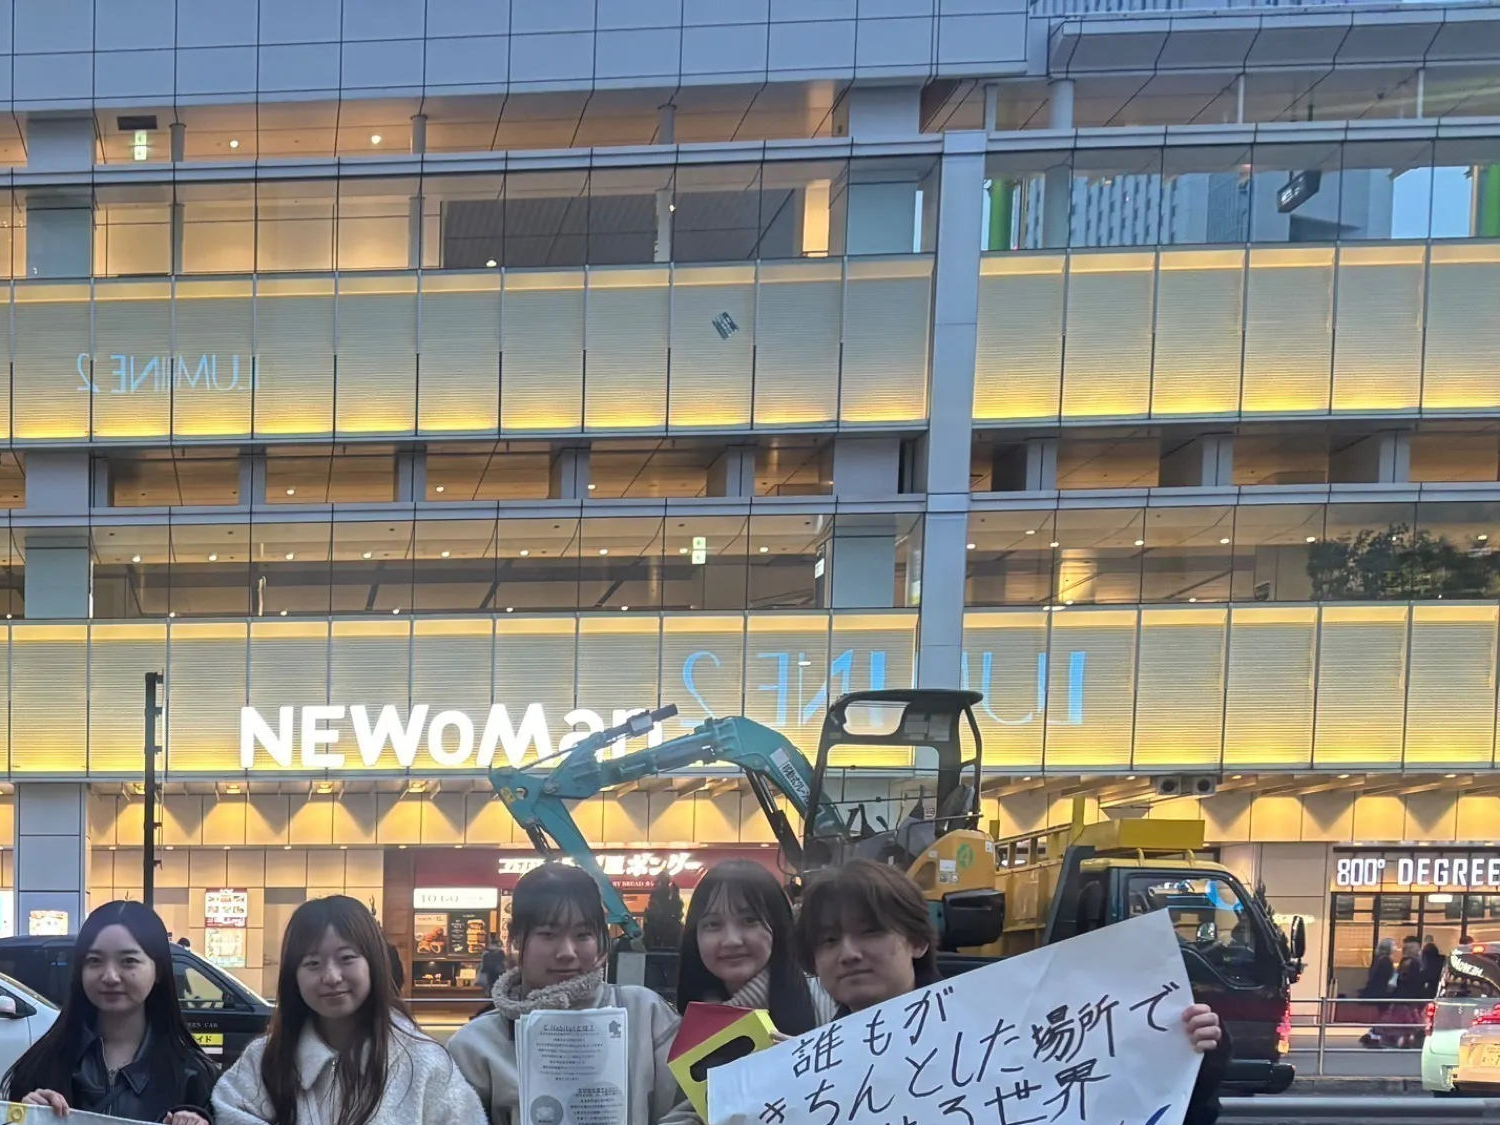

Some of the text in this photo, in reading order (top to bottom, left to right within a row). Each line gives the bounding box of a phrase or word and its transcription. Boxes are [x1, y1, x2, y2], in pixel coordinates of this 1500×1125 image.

[1397, 858, 1500, 886] DEGREE
[793, 986, 954, 1078] 誰もが
